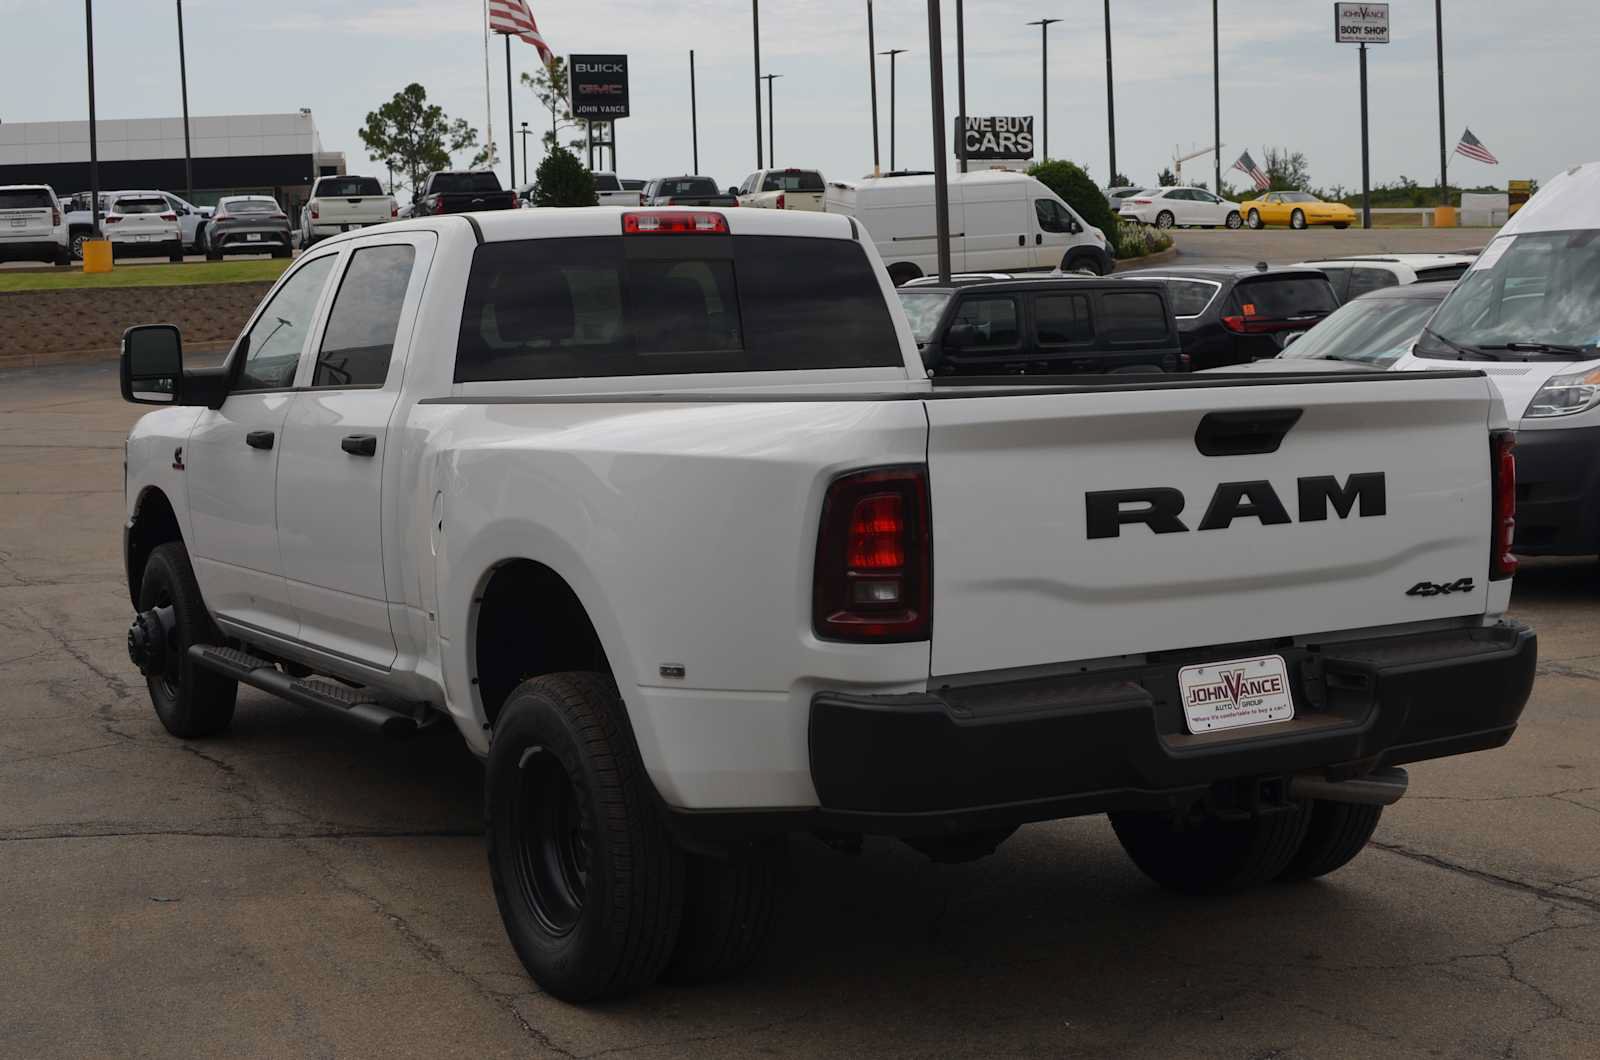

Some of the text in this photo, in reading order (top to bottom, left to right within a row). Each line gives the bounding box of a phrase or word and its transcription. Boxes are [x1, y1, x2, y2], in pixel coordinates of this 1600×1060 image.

[1341, 25, 1387, 35] BODY SHOP
[575, 63, 624, 72] BUICK
[578, 83, 623, 94] GMC
[577, 105, 626, 113] JOHN VANCE
[965, 116, 1032, 132] WE BUY
[965, 130, 1033, 153] CARS
[1085, 471, 1387, 540] RAM
[1215, 699, 1263, 711] AUTO GROUP
